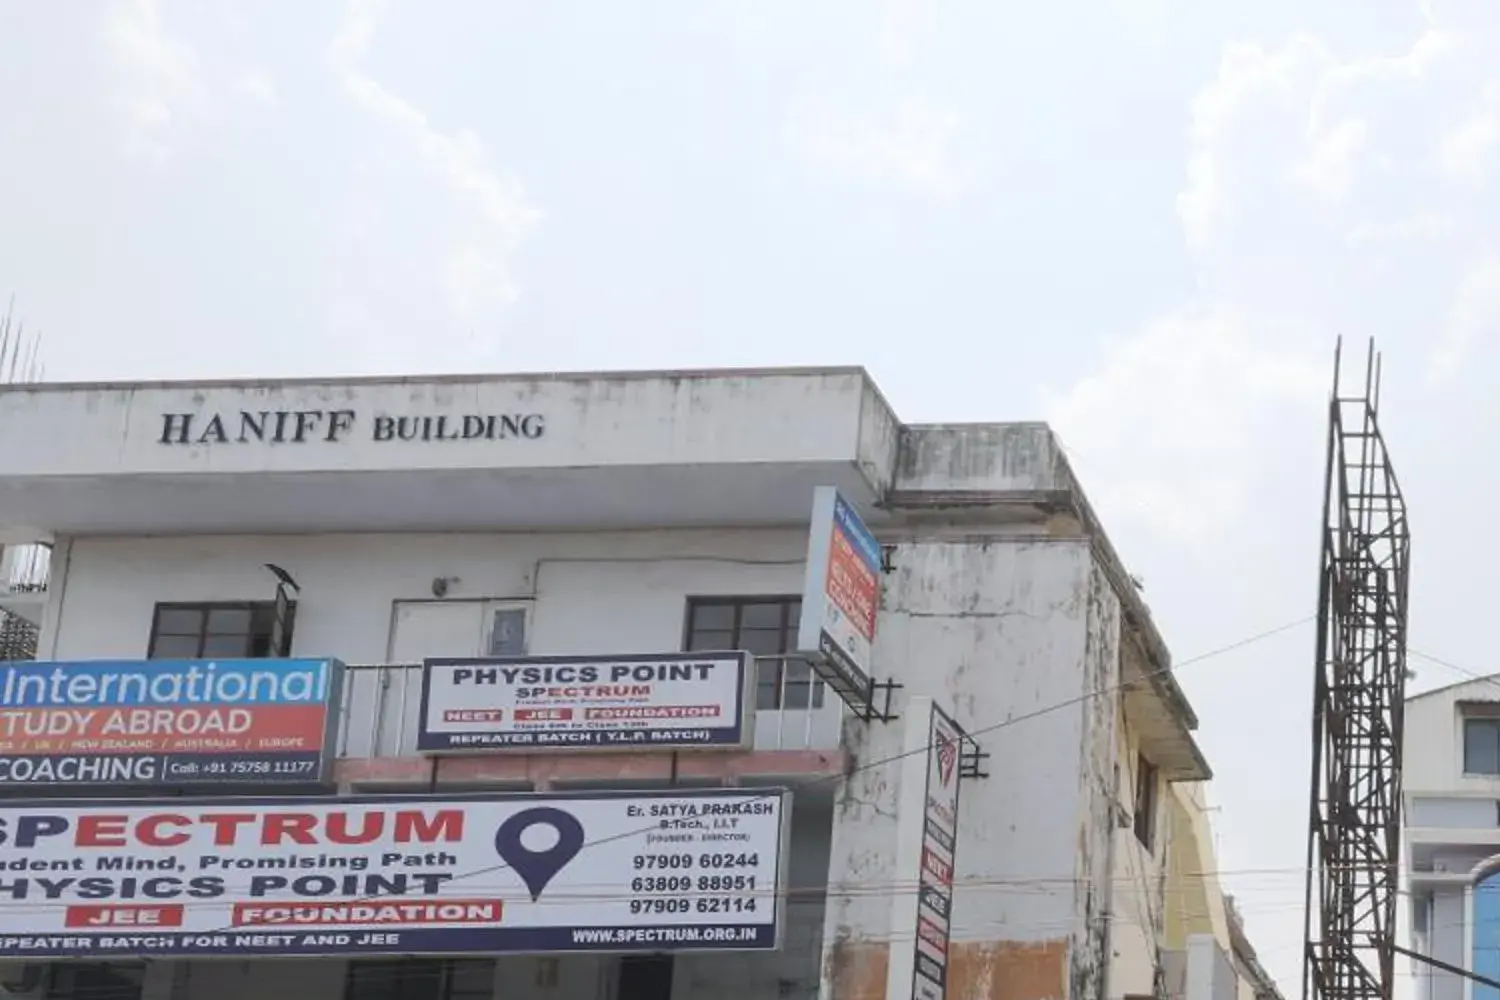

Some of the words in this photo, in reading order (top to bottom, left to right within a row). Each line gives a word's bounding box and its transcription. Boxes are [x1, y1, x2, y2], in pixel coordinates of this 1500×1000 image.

[157, 410, 356, 445] HANIFF
[372, 414, 545, 442] BUILDING
[453, 667, 599, 685] PHYSICS
[610, 663, 715, 683] POINT
[3, 663, 328, 704] International
[516, 684, 651, 698] SPECTRUM
[447, 710, 499, 721] NEET
[590, 704, 716, 718] FOUNDATION
[100, 708, 251, 735] ABROAD
[450, 734, 533, 744] REPEATER
[537, 732, 591, 742] BATCH
[651, 730, 711, 741] BATCH)
[170, 761, 200, 774] Call:
[203, 762, 227, 774] +91
[230, 761, 270, 774] 75758
[274, 760, 315, 773] 11177
[626, 804, 646, 818] Er.
[649, 803, 698, 817] SATYA
[702, 802, 774, 816] PRAKASH
[96, 854, 187, 873] Mind,
[200, 852, 370, 873] Promising
[381, 850, 458, 868] Path
[633, 855, 693, 870] 97909
[699, 853, 760, 868] 60244
[249, 873, 453, 898] POINT
[631, 876, 692, 892] 63809
[697, 875, 757, 891] 88951
[88, 908, 162, 926] JEE
[240, 903, 494, 924] FOUNDATION
[629, 899, 691, 915] 97909
[696, 898, 757, 914] 62114
[99, 936, 175, 949] BATCH
[181, 935, 228, 948] FOR
[235, 934, 296, 948] NEET
[302, 934, 351, 947] AND
[357, 933, 399, 946] JEE
[572, 928, 758, 943] WWW.SPECTRUM.ORG.IN
